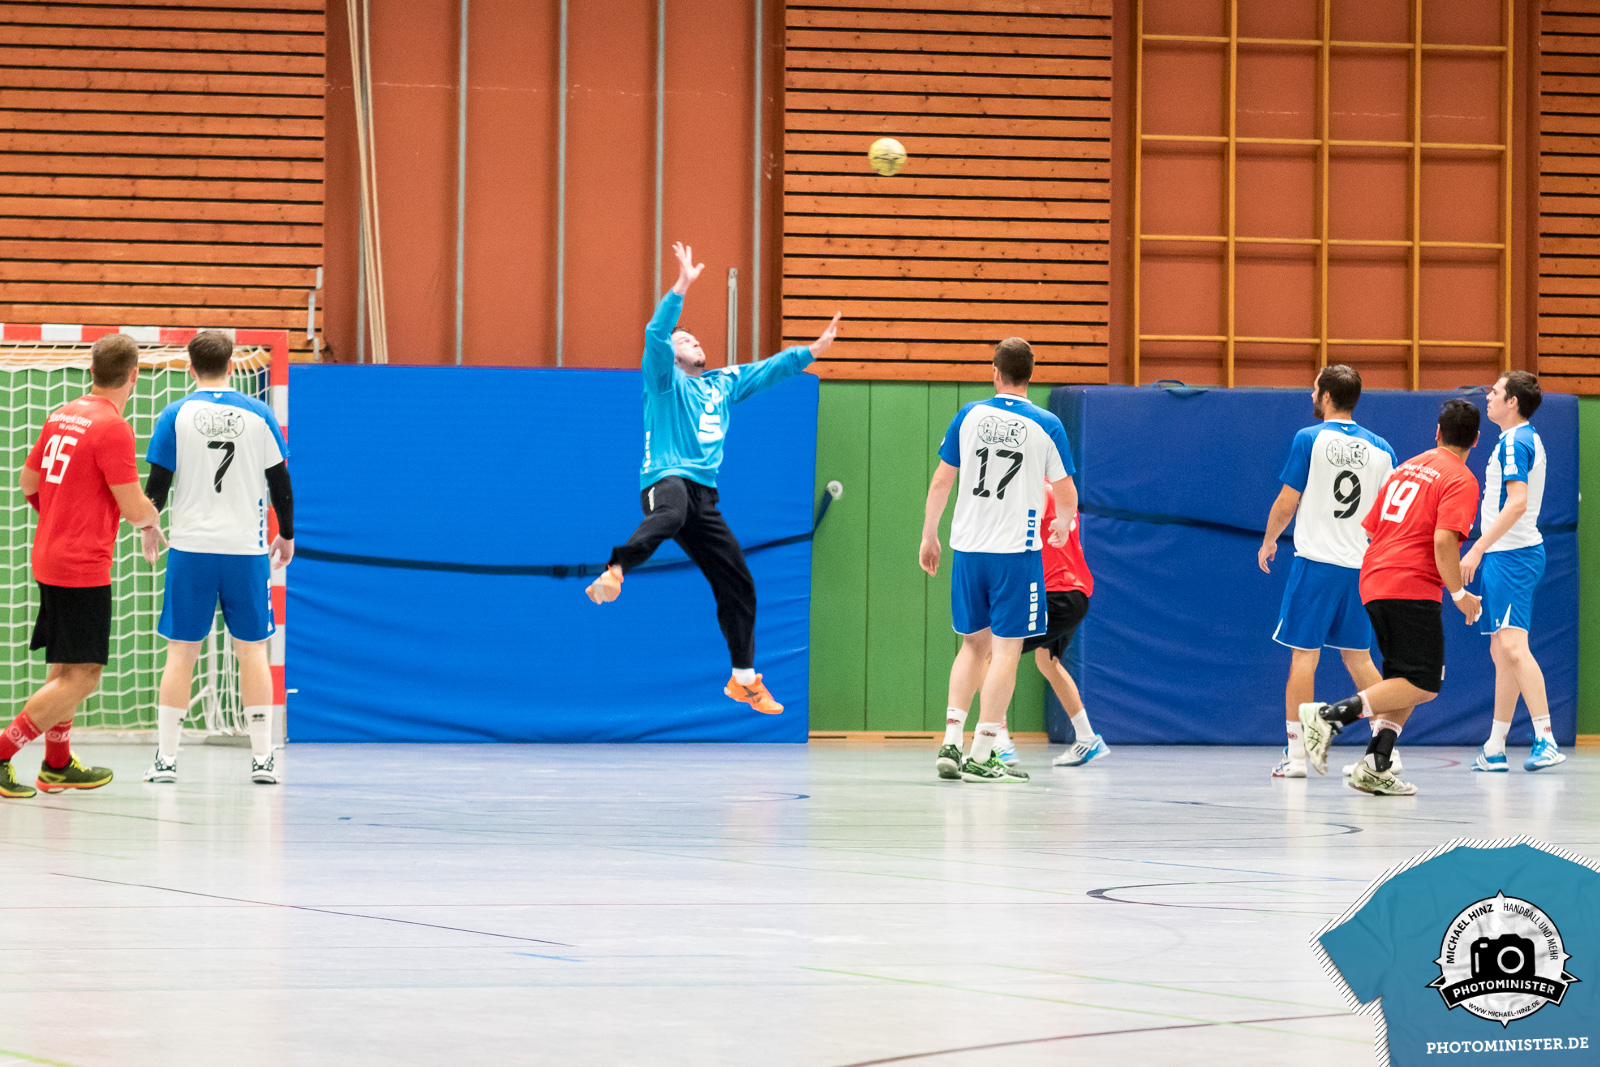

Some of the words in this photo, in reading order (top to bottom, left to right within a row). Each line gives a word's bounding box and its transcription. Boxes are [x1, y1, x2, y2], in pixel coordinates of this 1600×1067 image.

[41, 434, 77, 484] 45
[207, 440, 235, 493] 7
[972, 446, 1023, 500] 17
[1333, 470, 1361, 519] 9
[1380, 479, 1420, 523] 19
